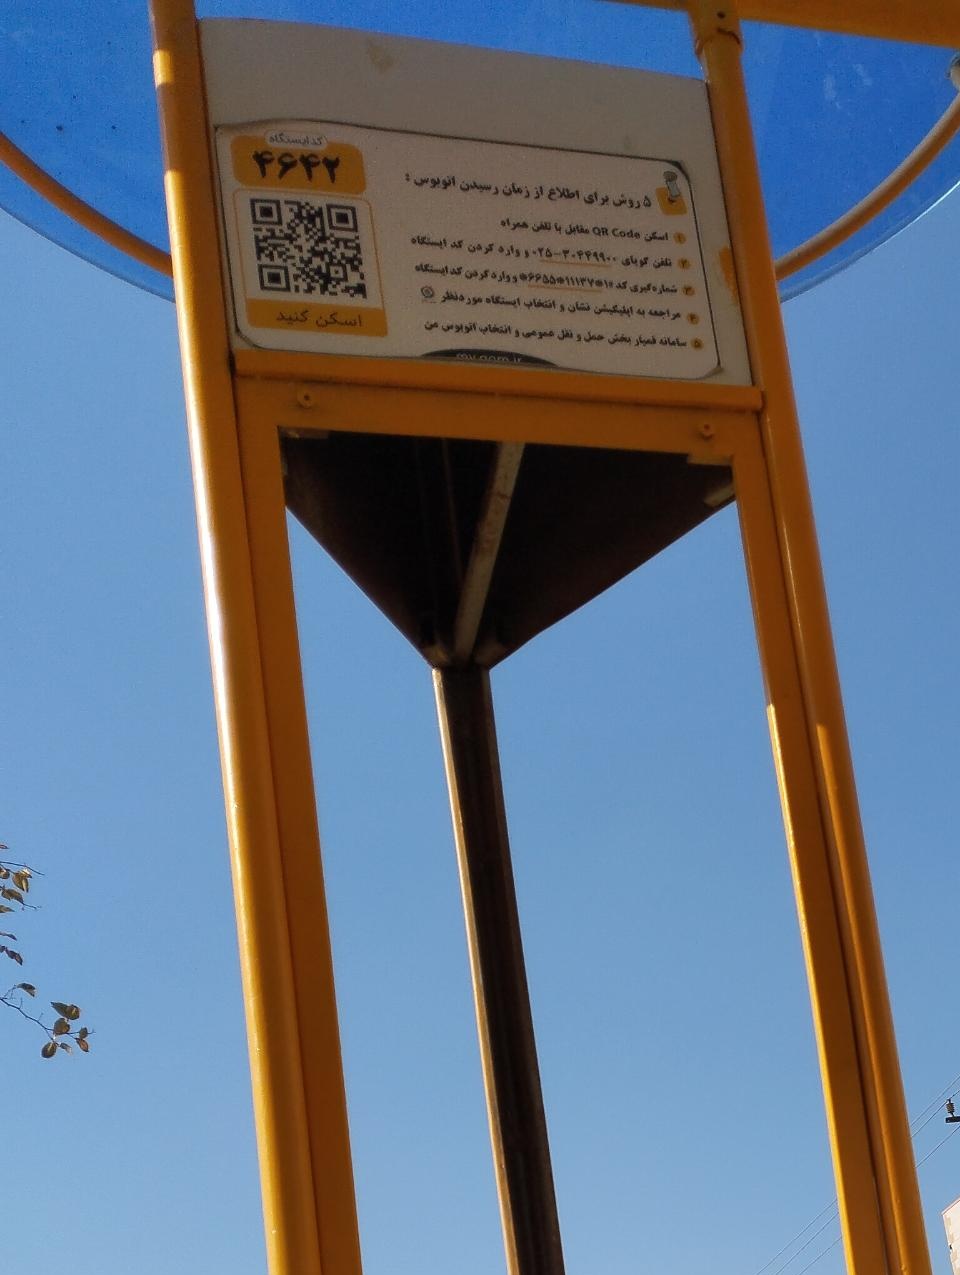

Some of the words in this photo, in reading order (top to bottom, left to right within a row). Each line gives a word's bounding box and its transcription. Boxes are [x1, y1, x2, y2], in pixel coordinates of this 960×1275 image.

[252, 150, 340, 184] ۴۶۴۲
[413, 175, 456, 190] اتوبوس
[459, 180, 499, 195] رسیدن
[502, 182, 530, 198] زمان
[533, 185, 544, 200] از
[547, 186, 580, 202] اطلاع
[583, 191, 610, 206] برای
[612, 194, 641, 209] روش
[643, 195, 652, 208] ۵
[500, 217, 529, 231] همراه
[532, 221, 552, 233] تلفن
[553, 222, 562, 235] با
[564, 223, 590, 236] مقابل
[592, 226, 609, 238] QR
[611, 227, 641, 240] Code
[643, 231, 669, 243] اسکن
[410, 234, 447, 250] ایستگاه
[450, 239, 464, 250] کد
[467, 242, 495, 256] کردن
[498, 244, 521, 258] وارد
[523, 248, 530, 259] و
[415, 262, 448, 277] ایستگاه
[652, 257, 672, 269] تلفن
[449, 266, 463, 276] کد
[464, 268, 490, 281] کردن
[491, 270, 511, 284] وارد
[615, 280, 628, 290] کد
[485, 294, 521, 309] ایستگاه
[523, 298, 556, 311] انتخاب
[559, 303, 565, 313] و
[567, 301, 591, 314] نشان
[593, 303, 634, 318] اپلیکیشن
[635, 309, 646, 320] به
[647, 307, 682, 321] مراجعه
[276, 309, 310, 326] کنید
[315, 312, 363, 329] اسکن
[424, 320, 439, 331] من
[440, 321, 477, 335] اتوبوس
[478, 323, 512, 336] انتخاب
[513, 328, 520, 338] و
[521, 327, 555, 340] عمومی
[556, 327, 574, 341] نقل
[575, 332, 582, 343] و
[583, 331, 605, 343] حمل
[607, 333, 632, 346] بخش
[658, 336, 688, 348] سامانه
